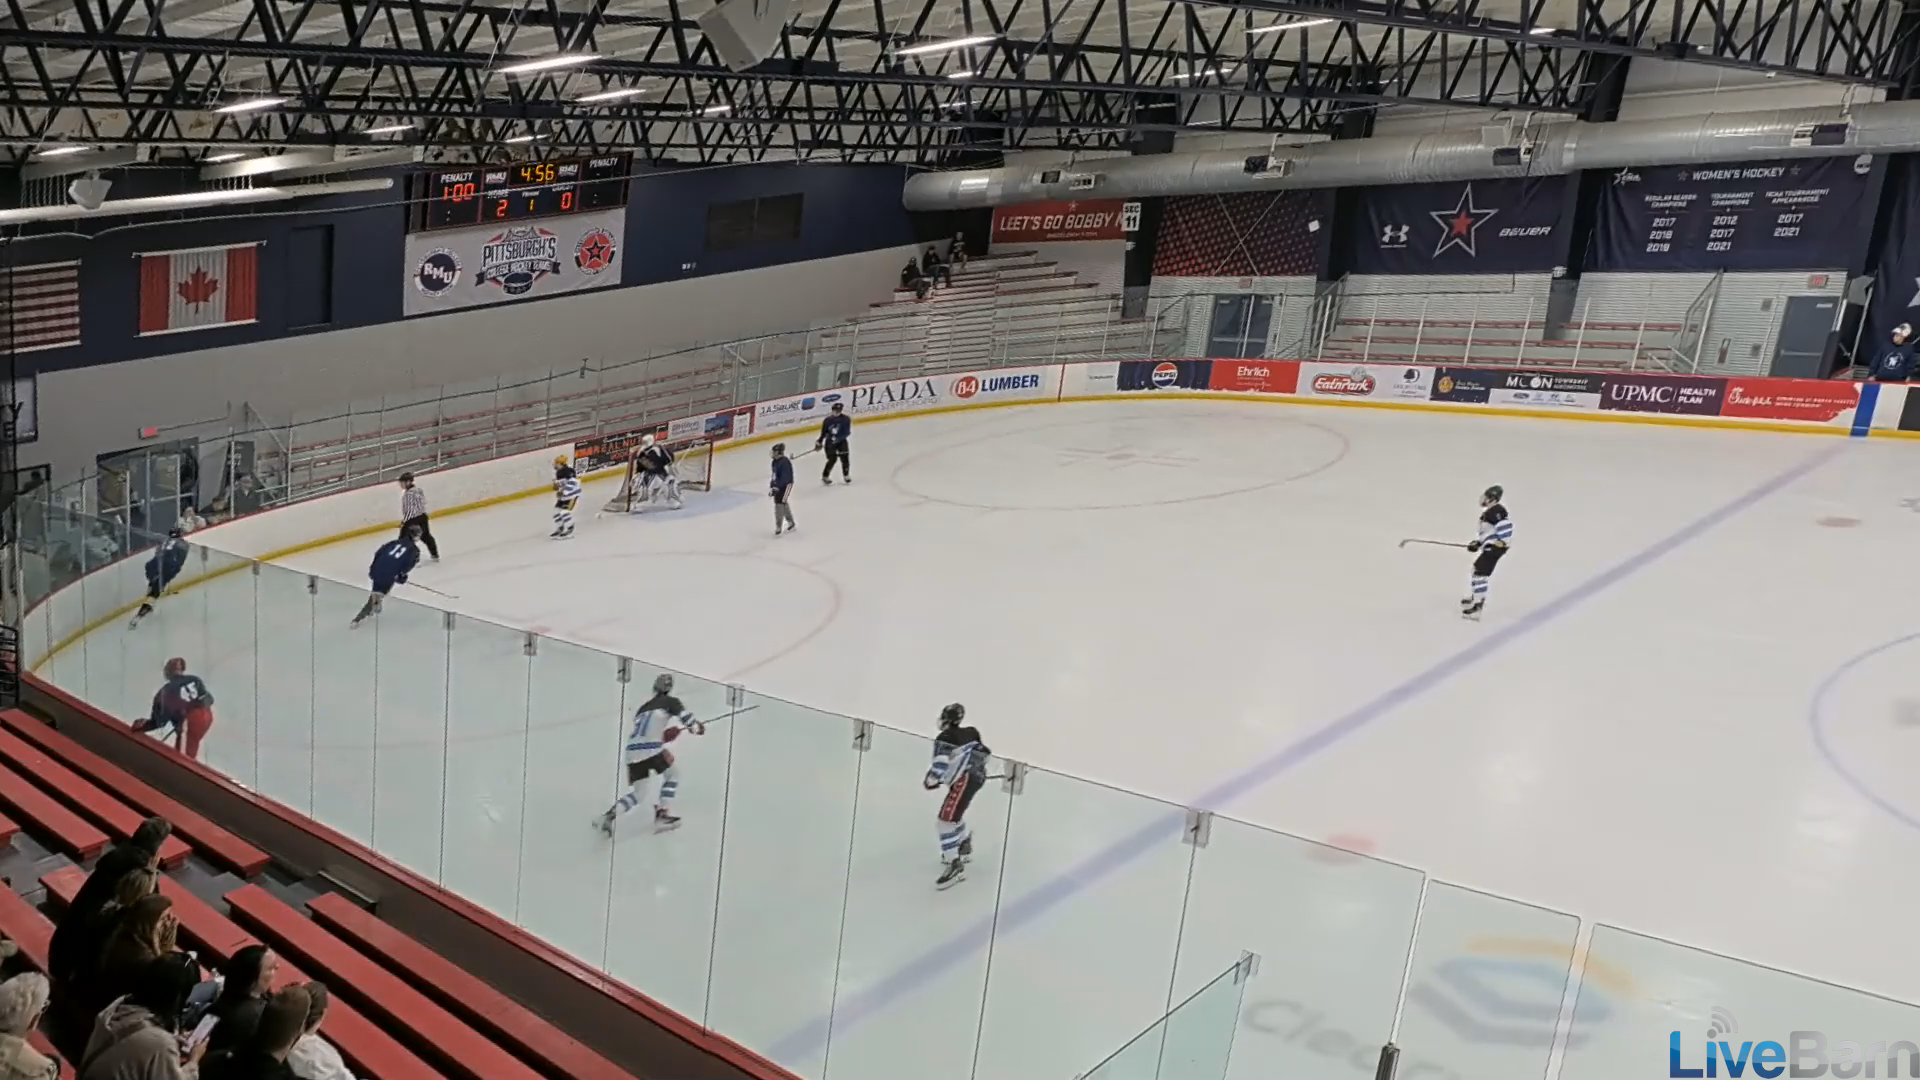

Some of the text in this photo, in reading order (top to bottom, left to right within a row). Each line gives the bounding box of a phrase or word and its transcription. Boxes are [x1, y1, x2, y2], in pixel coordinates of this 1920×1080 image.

[440, 172, 473, 183] PENALTY
[520, 163, 555, 182] 4:56
[1692, 166, 1786, 181] WOMEN'S HOCKEY
[443, 183, 475, 202] 1:00
[529, 199, 535, 211] 1
[560, 192, 573, 210] 0
[496, 200, 508, 217] 2
[1124, 204, 1140, 213] SEC
[1000, 216, 1041, 231] LEET'S
[1043, 215, 1064, 230] GO
[1065, 211, 1114, 229] BOBBY
[1125, 215, 1138, 230] 11
[1652, 217, 1677, 228] 2017
[1713, 215, 1738, 226] 2012
[1777, 213, 1804, 224] 2017
[1499, 226, 1552, 238] BAUER
[1710, 228, 1735, 238] 2017
[1773, 227, 1800, 237] 2021
[483, 237, 557, 267] PITTSBURGH'S
[1706, 241, 1732, 251] 2021
[424, 262, 453, 284] RMU
[1154, 371, 1176, 379] PEPSI
[1237, 366, 1270, 377] Ehrlich
[957, 375, 1039, 395] 84 LUMBER
[852, 378, 937, 408] PIADA
[1611, 384, 1672, 403] UPMC
[1680, 388, 1716, 396] HEALTH
[1678, 396, 1704, 404] PLAN
